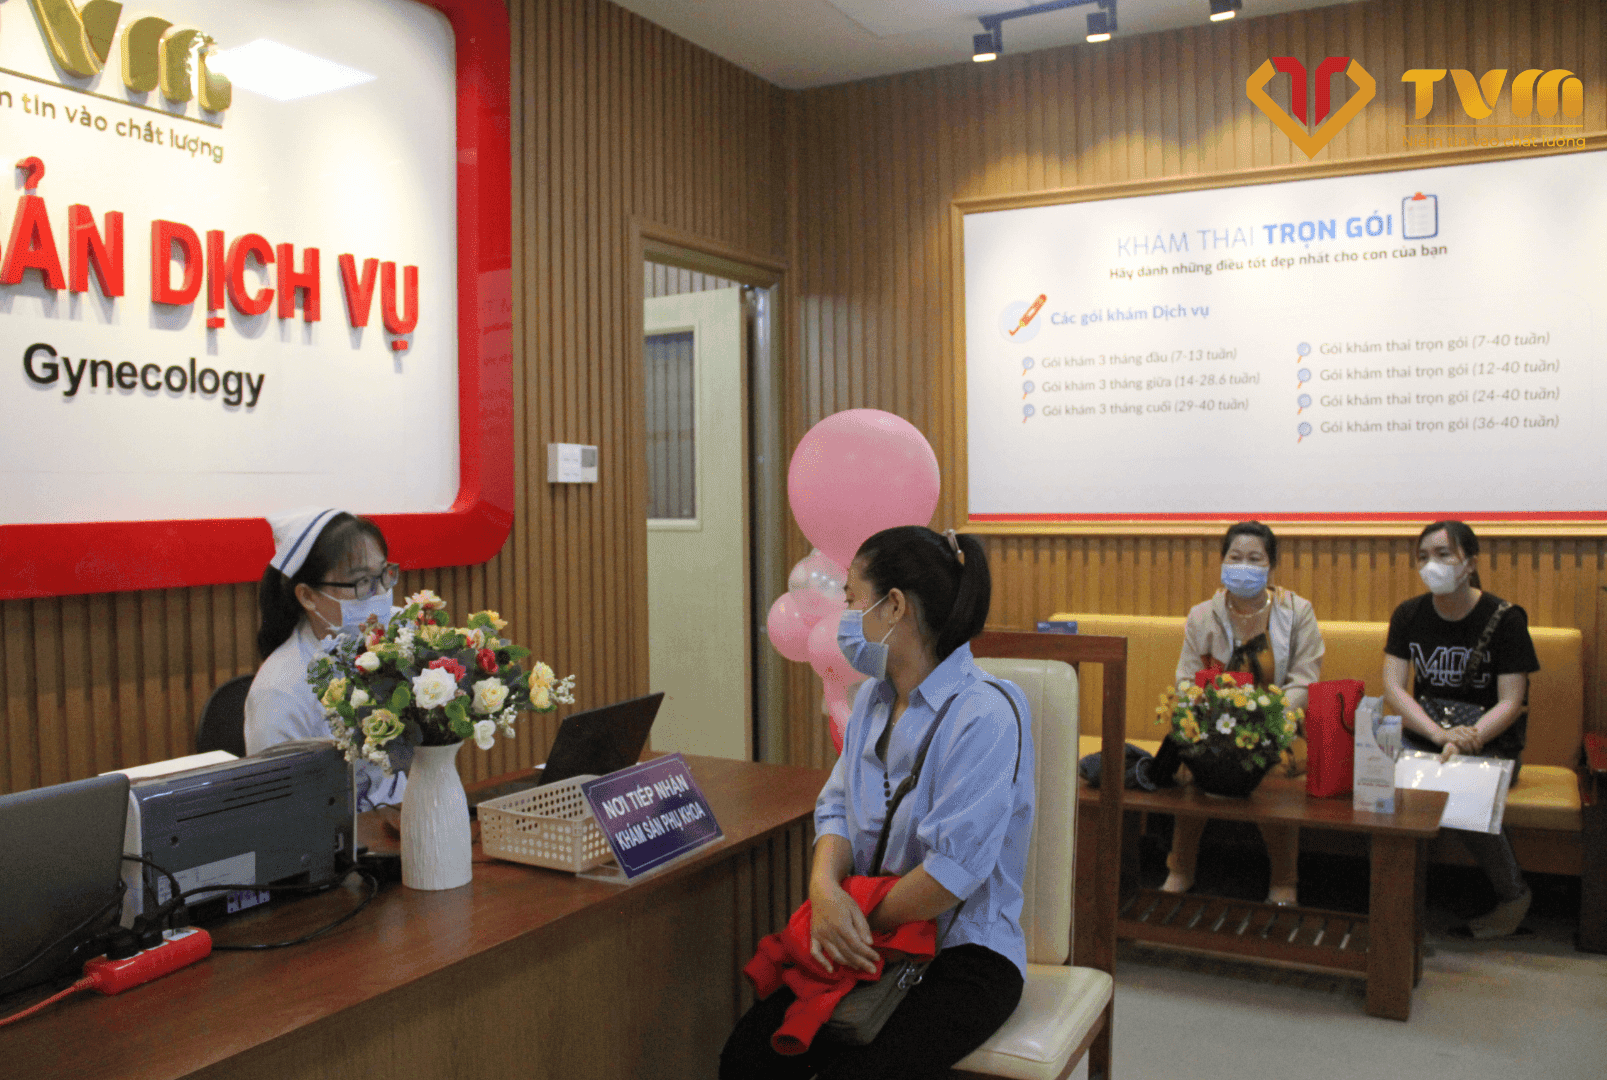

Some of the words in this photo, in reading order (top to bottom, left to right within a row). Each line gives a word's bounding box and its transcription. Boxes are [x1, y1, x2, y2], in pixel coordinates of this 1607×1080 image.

[64, 105, 108, 132] vào
[115, 118, 164, 145] chất
[170, 128, 224, 164] lượng
[1196, 226, 1254, 251] THAI
[1263, 219, 1336, 249] TRỌN
[1346, 210, 1392, 238] GÓI
[0, 156, 124, 297] ẢN
[151, 219, 321, 329] DỊCH
[338, 253, 419, 350] VỤ
[1334, 250, 1359, 263] cho
[1362, 249, 1388, 261] con
[1050, 311, 1076, 325] Các
[1081, 309, 1103, 326] gói
[1107, 307, 1148, 322] khám
[1152, 304, 1187, 322] Dịch
[1191, 305, 1210, 319] vụ
[1386, 339, 1411, 351] thai
[1099, 354, 1106, 366] 3
[1109, 353, 1142, 366] tháng
[23, 343, 265, 406] Gynecology
[1386, 365, 1411, 378] thai
[1099, 379, 1106, 390] 3
[1109, 378, 1142, 391] tháng
[1386, 392, 1411, 405] thai
[1099, 403, 1106, 414] 3
[1110, 402, 1143, 415] tháng
[1386, 418, 1411, 431] thai
[677, 801, 706, 825] KHOA
